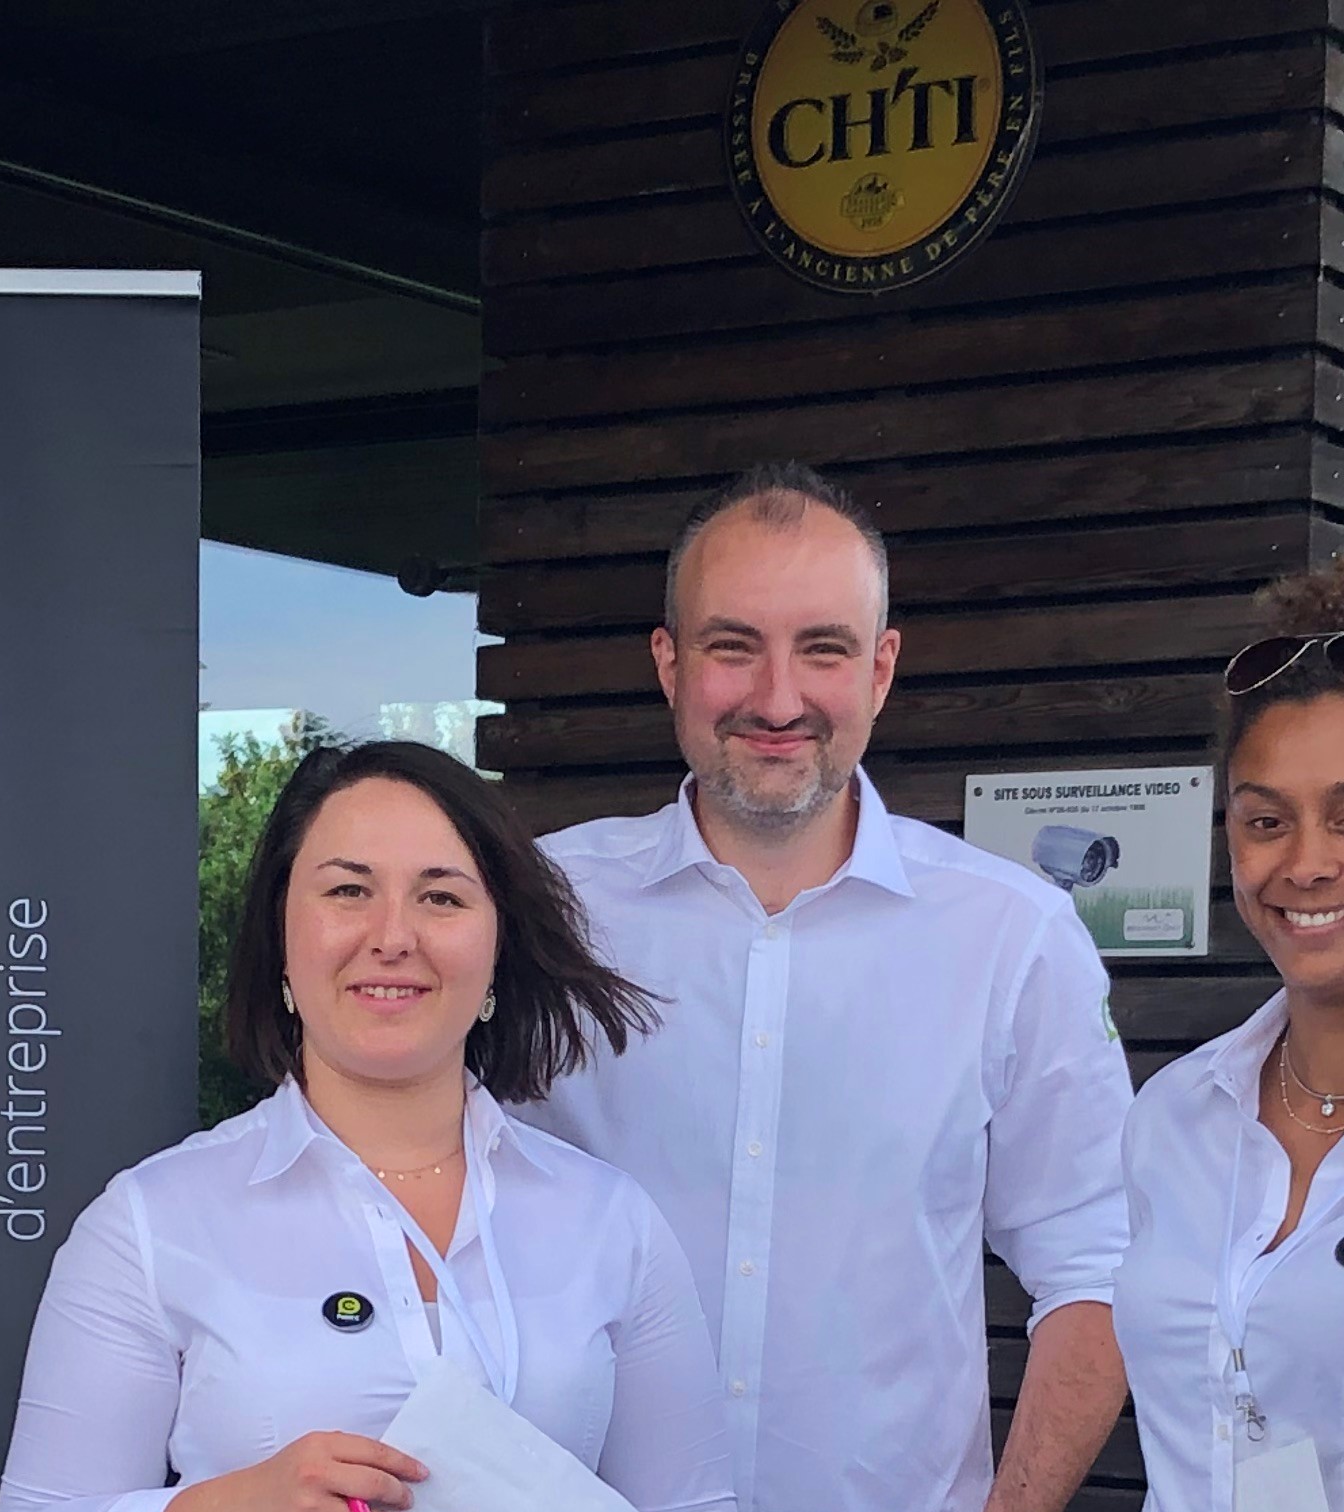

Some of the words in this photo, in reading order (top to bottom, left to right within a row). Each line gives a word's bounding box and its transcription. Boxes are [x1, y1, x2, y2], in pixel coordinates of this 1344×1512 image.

[925, 230, 958, 262] DE
[994, 787, 1019, 801] SITE
[1022, 786, 1052, 800] SOUS
[1055, 783, 1142, 799] SURVEILLANCE
[1144, 782, 1180, 796] VIDEO
